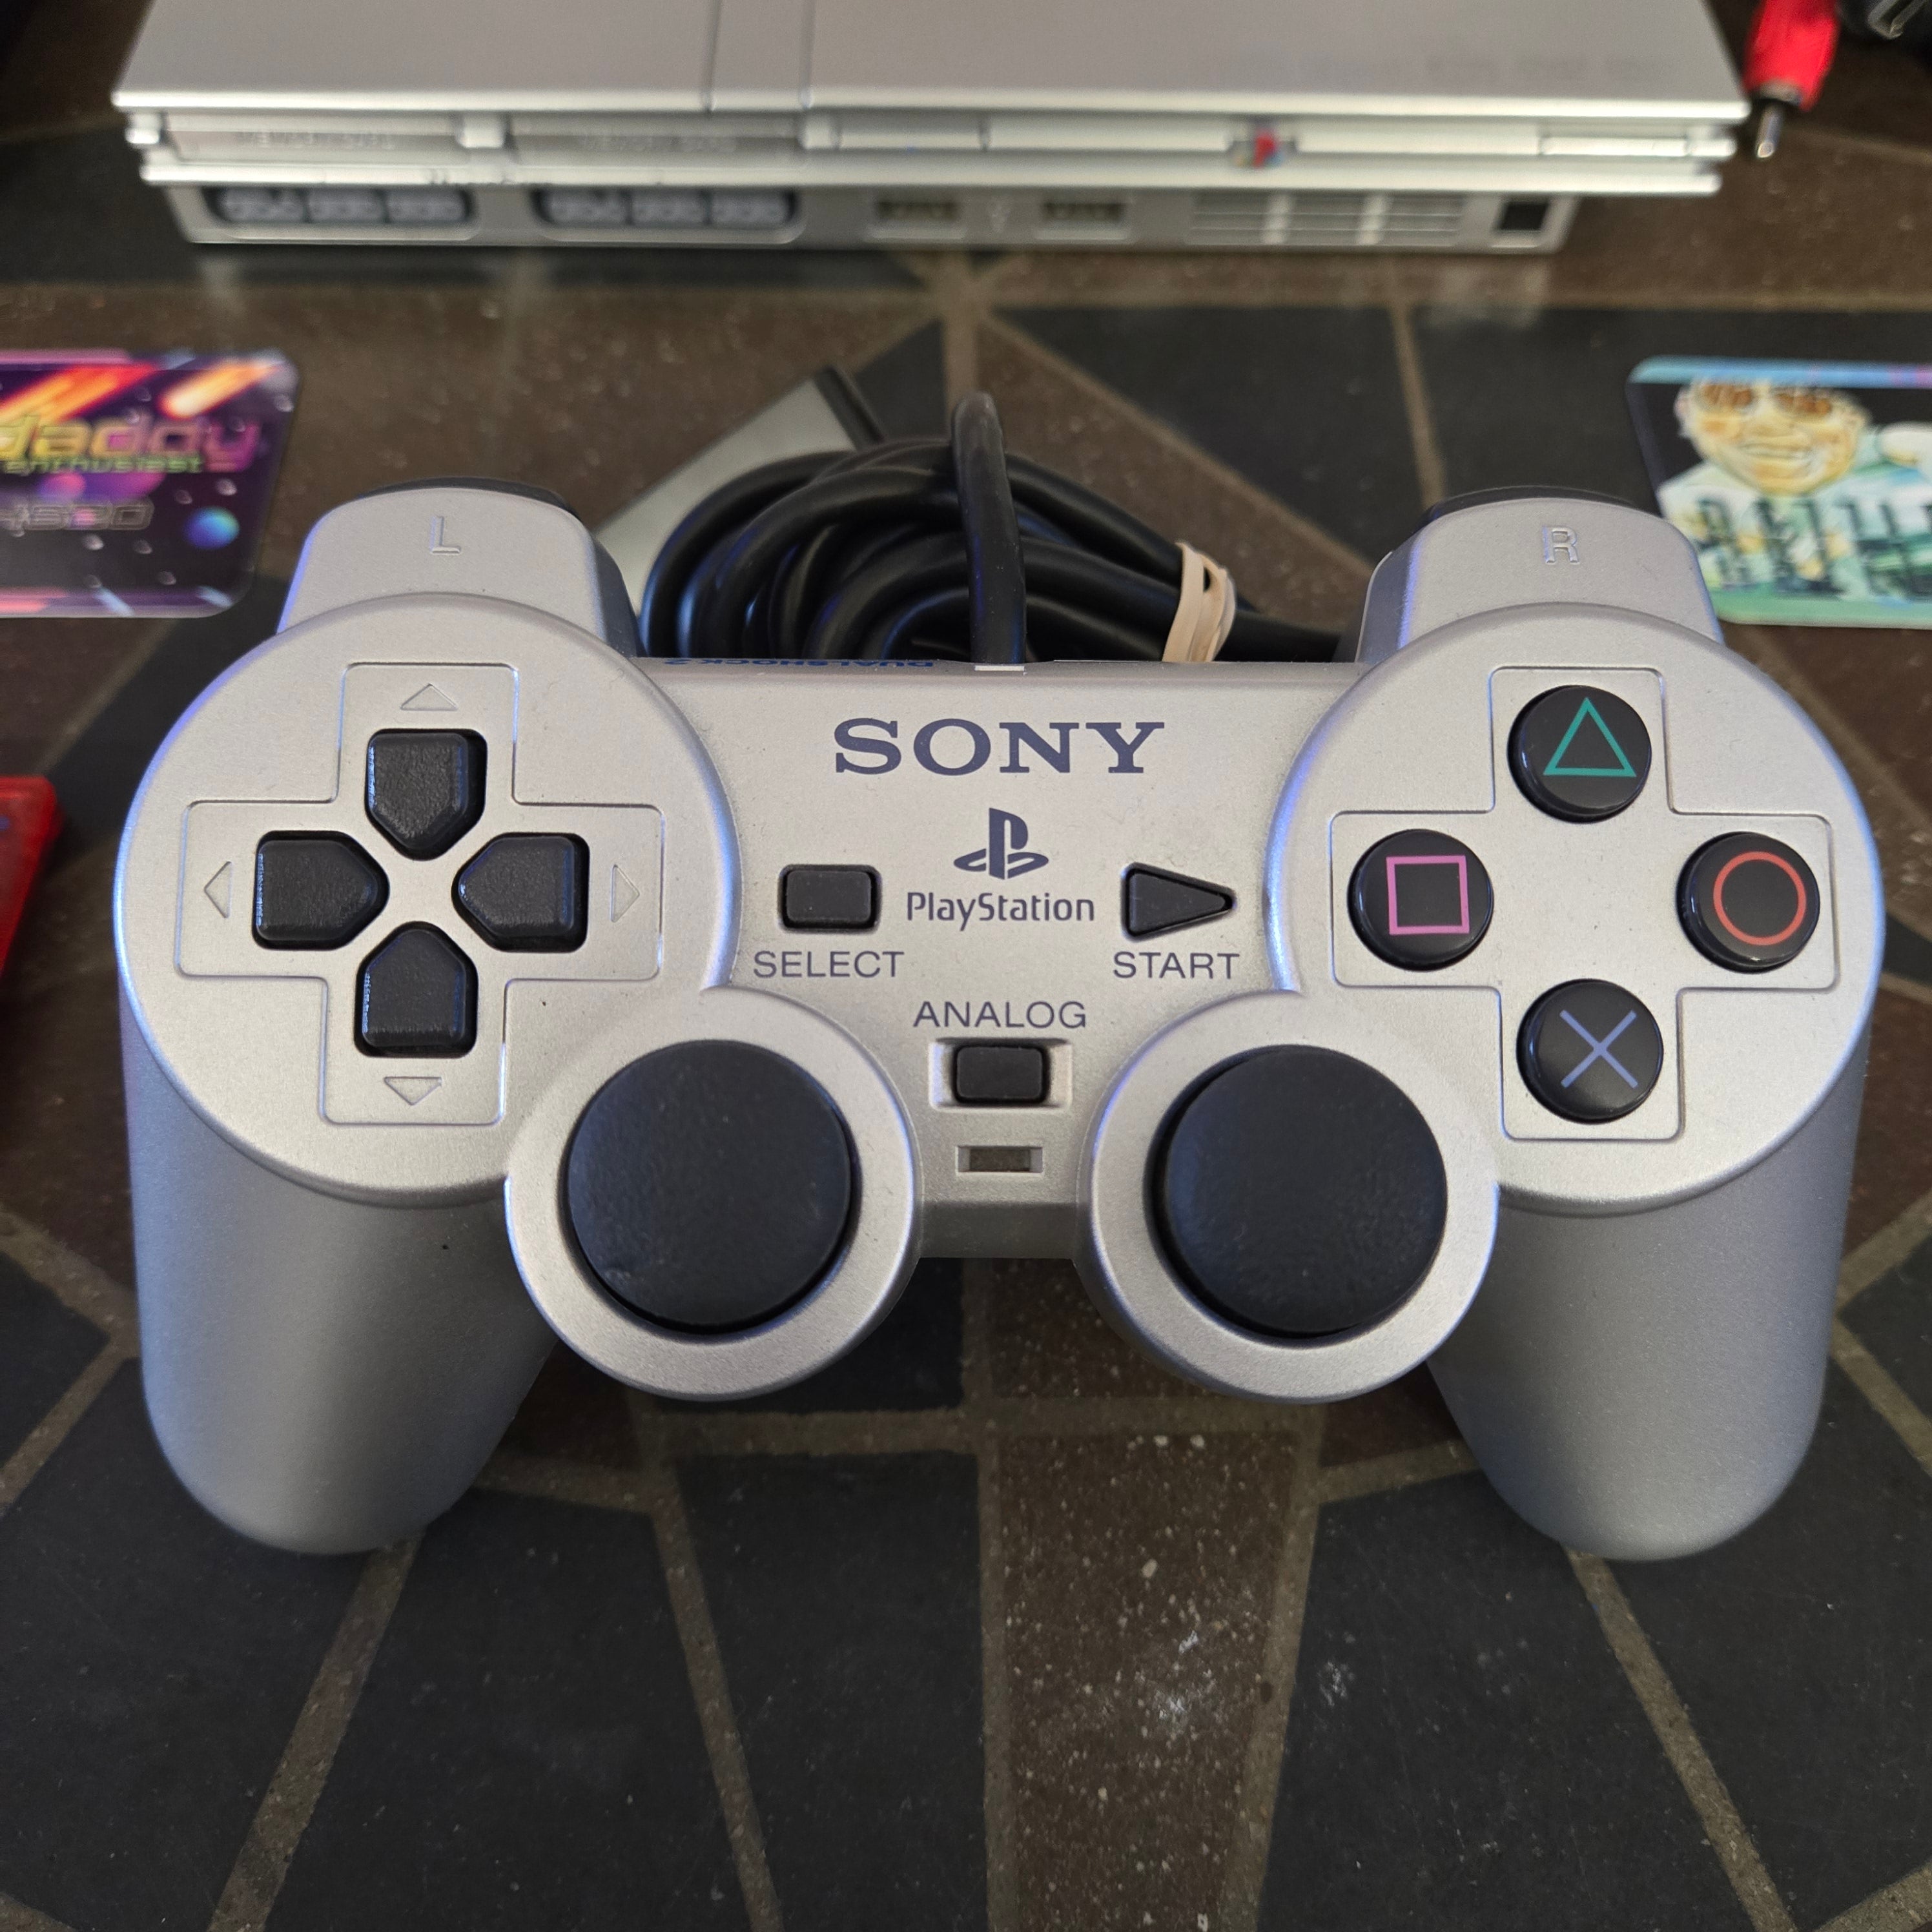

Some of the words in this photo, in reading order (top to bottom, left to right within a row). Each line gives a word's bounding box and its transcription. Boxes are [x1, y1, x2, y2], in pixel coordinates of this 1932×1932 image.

[430, 515, 461, 555] L
[1541, 525, 1580, 565] R
[834, 717, 1165, 776] SONY
[907, 892, 1095, 932] PlayStation
[752, 950, 905, 979] SELECT
[1113, 951, 1241, 980] START
[912, 1000, 1087, 1029] ANALOG
